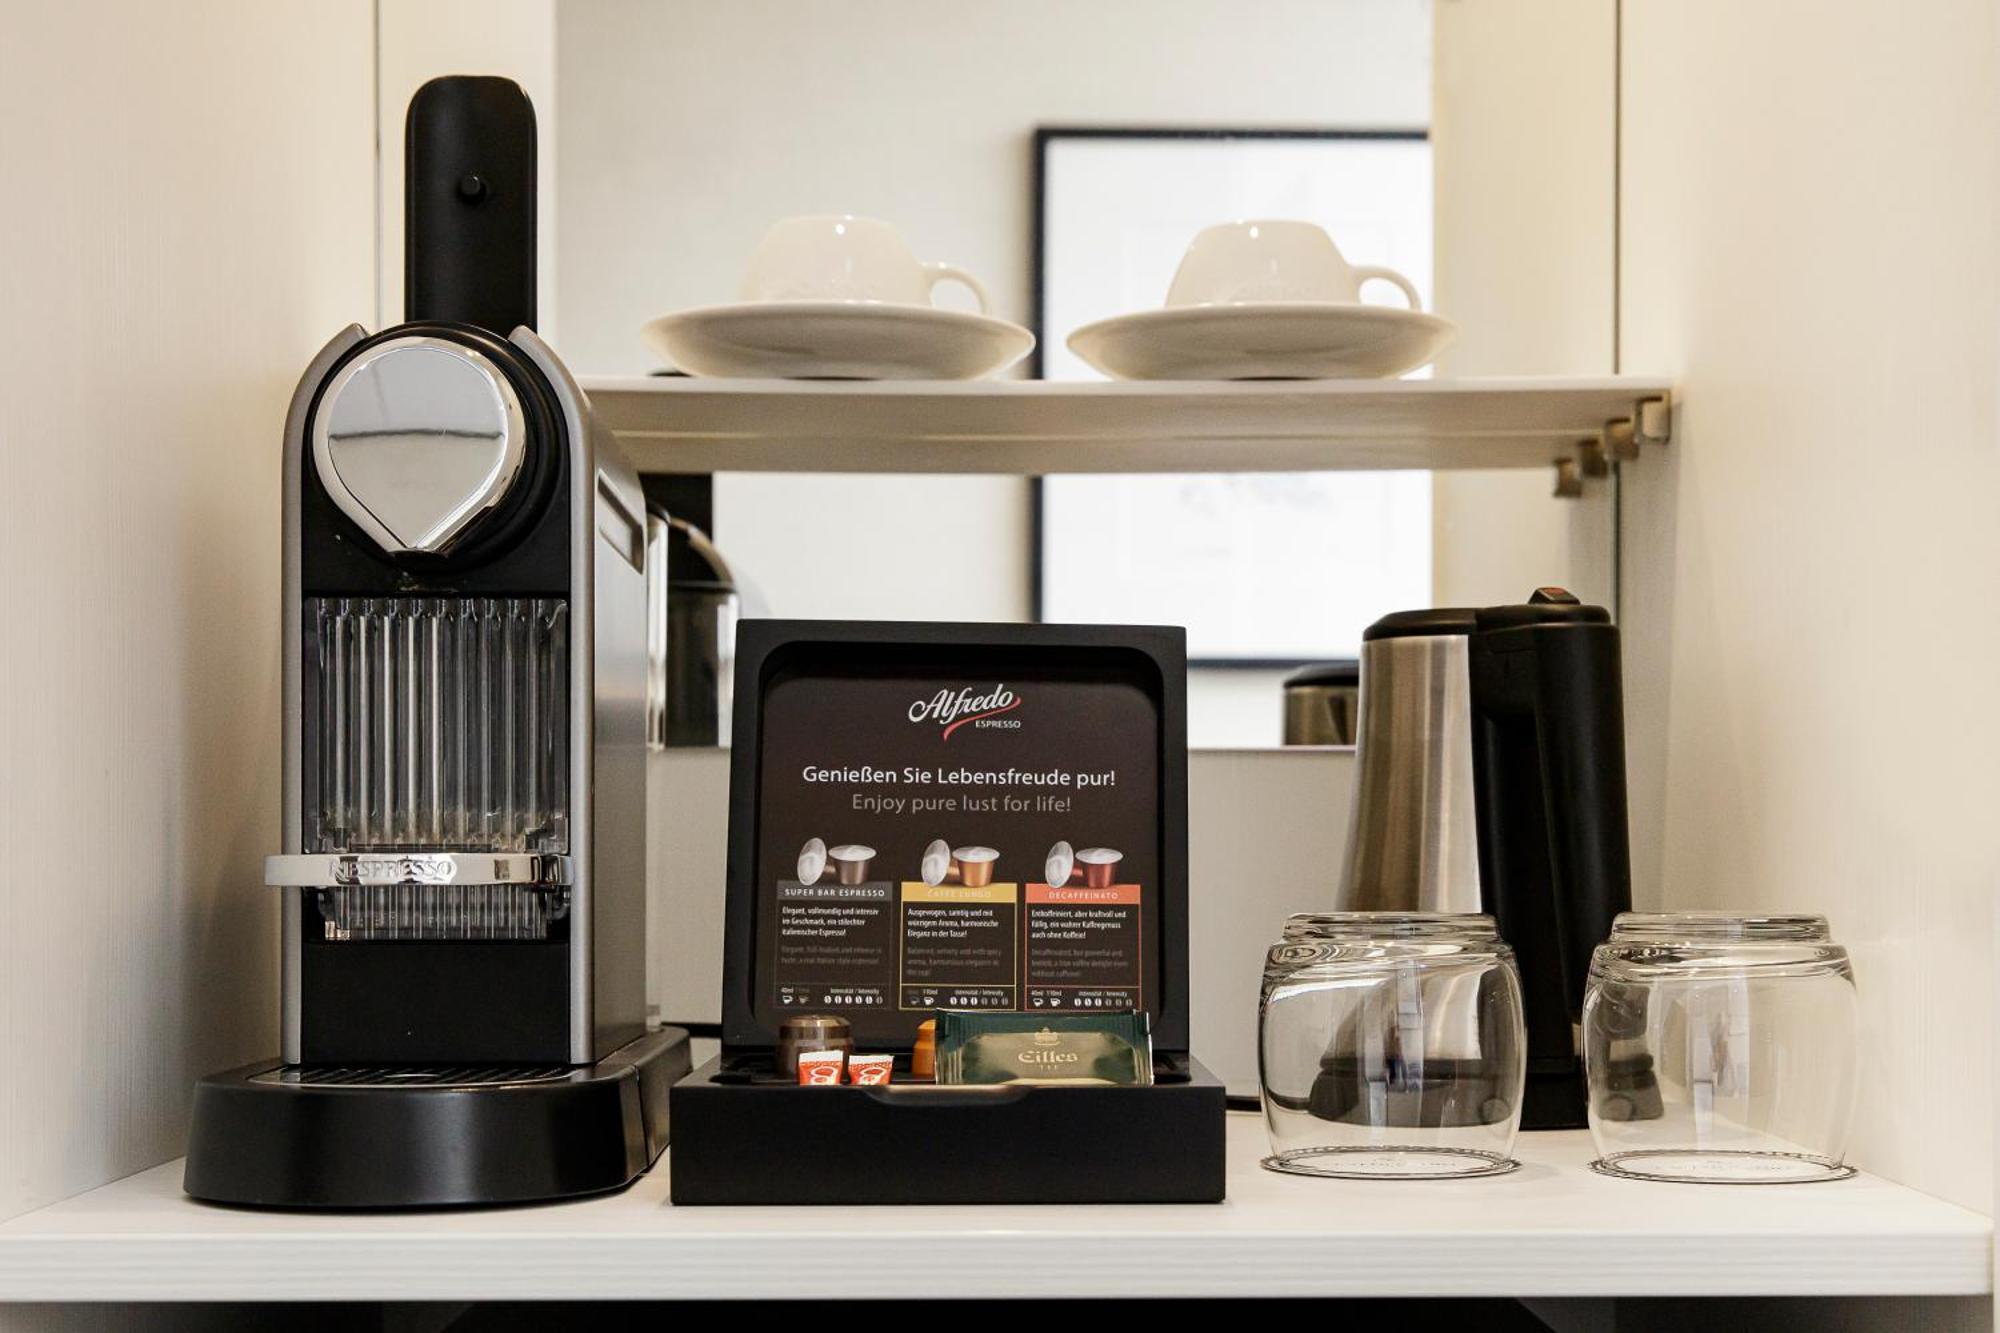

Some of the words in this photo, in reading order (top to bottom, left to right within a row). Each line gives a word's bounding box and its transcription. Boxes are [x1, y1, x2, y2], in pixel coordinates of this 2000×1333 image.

[908, 683, 1013, 724] Alfredo
[975, 720, 1021, 728] ESPRESSO
[802, 766, 897, 784] Genießen
[903, 767, 932, 784] Sie
[937, 768, 1071, 786] Lebensfreude
[1076, 770, 1116, 789] pur!
[852, 794, 906, 814] Enjoy
[911, 798, 958, 814] pure
[962, 795, 997, 811] lust
[1003, 795, 1031, 811] for
[1036, 795, 1072, 812] life!
[784, 888, 814, 896] SUPER
[817, 888, 835, 896] BAR
[839, 889, 885, 897] ESPRESSO
[1048, 891, 1119, 899] DECAFFEINATO
[842, 907, 854, 915] und
[970, 909, 982, 917] und
[1017, 1050, 1079, 1063] Eilles
